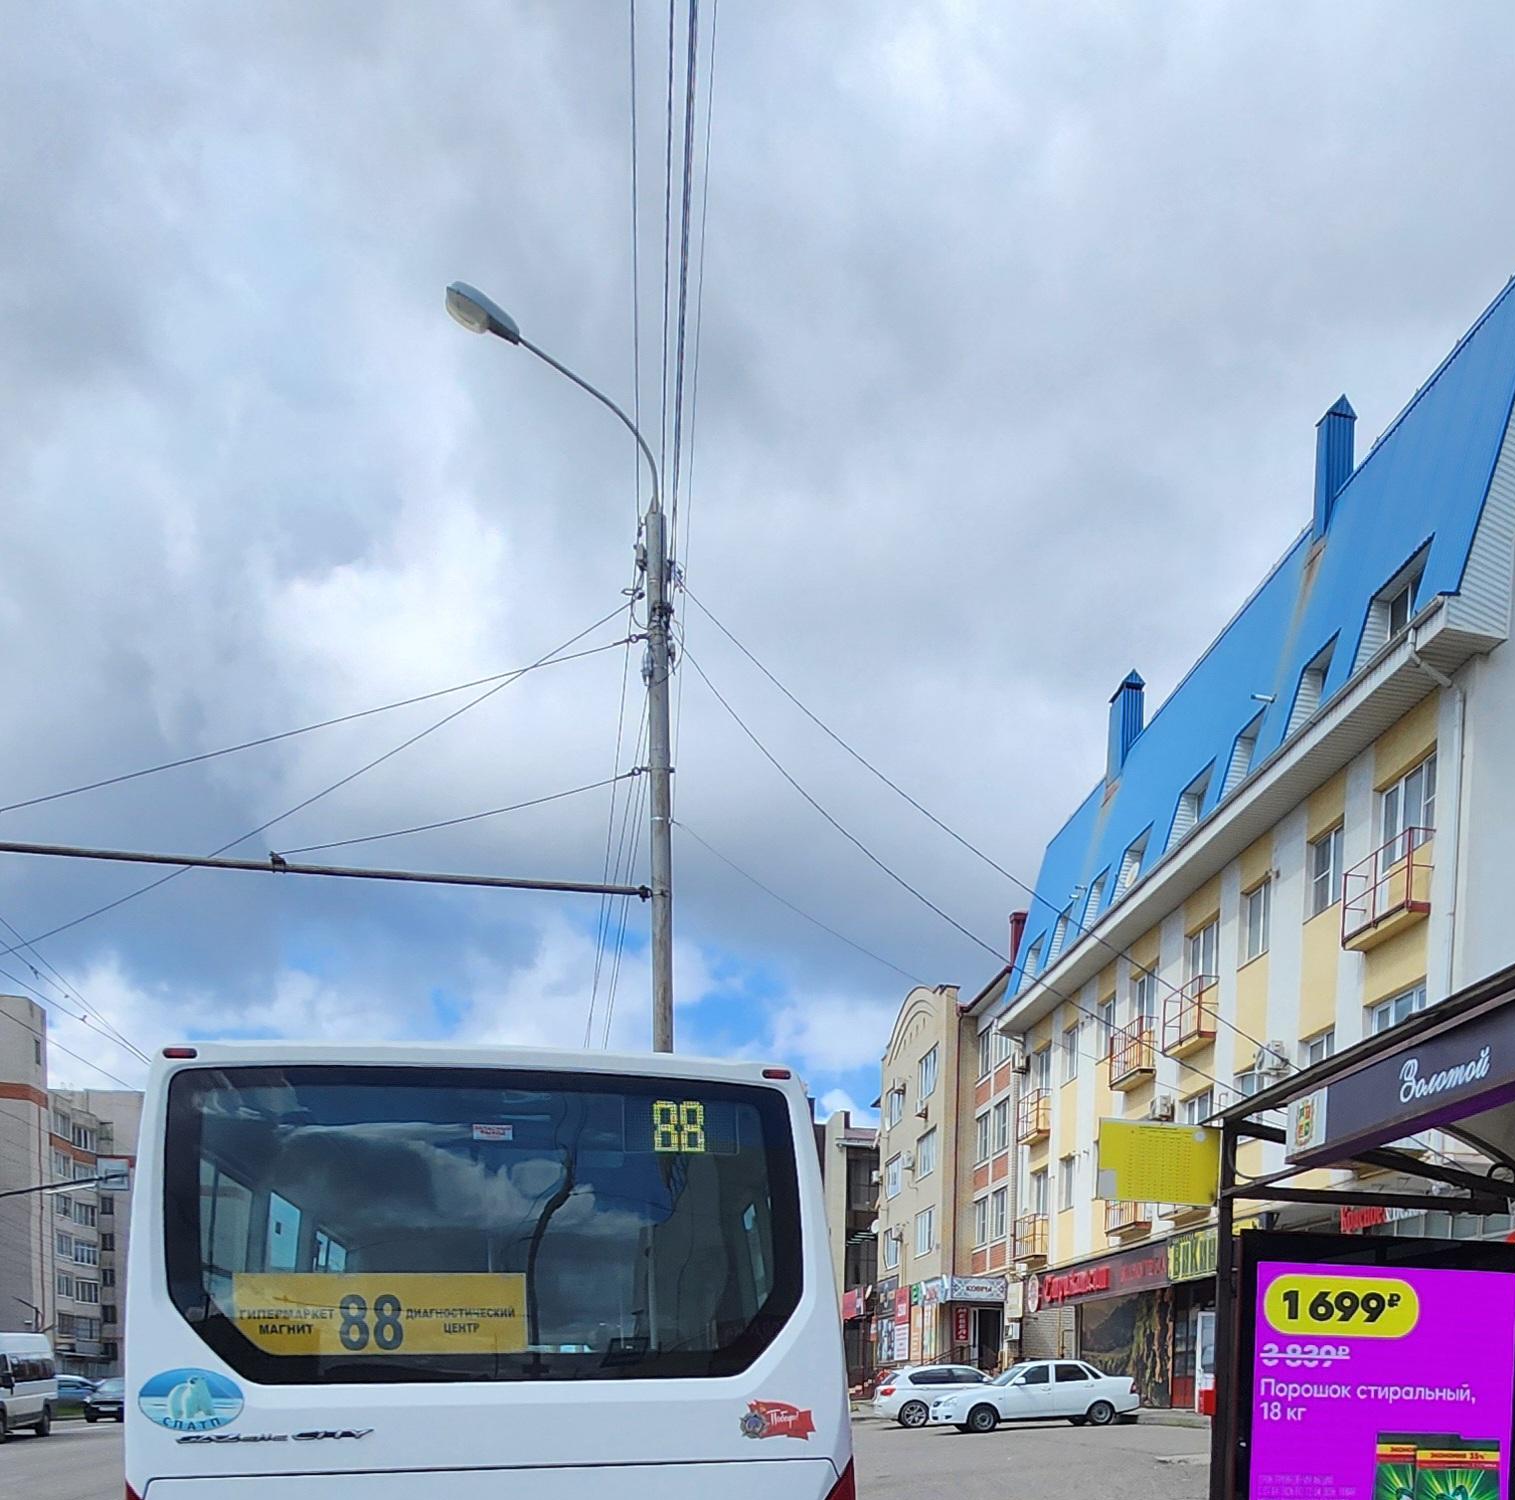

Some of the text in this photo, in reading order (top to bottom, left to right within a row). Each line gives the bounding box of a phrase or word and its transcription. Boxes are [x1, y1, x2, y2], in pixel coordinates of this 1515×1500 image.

[1399, 1046, 1491, 1104] Золотой
[653, 1100, 706, 1152] 88
[239, 1308, 335, 1320] ГИПЕРМАРКЕТ
[405, 1307, 516, 1320] ДИАГНОСТИЧЕСКИЙ
[259, 1323, 314, 1335] МАГНИТ
[339, 1294, 404, 1351] 88
[443, 1322, 480, 1334] ЦЕНТР
[1260, 1378, 1476, 1404] Порошок стиральный,
[1259, 1402, 1307, 1421] 18 кг
[162, 1416, 221, 1431] СПАТП
